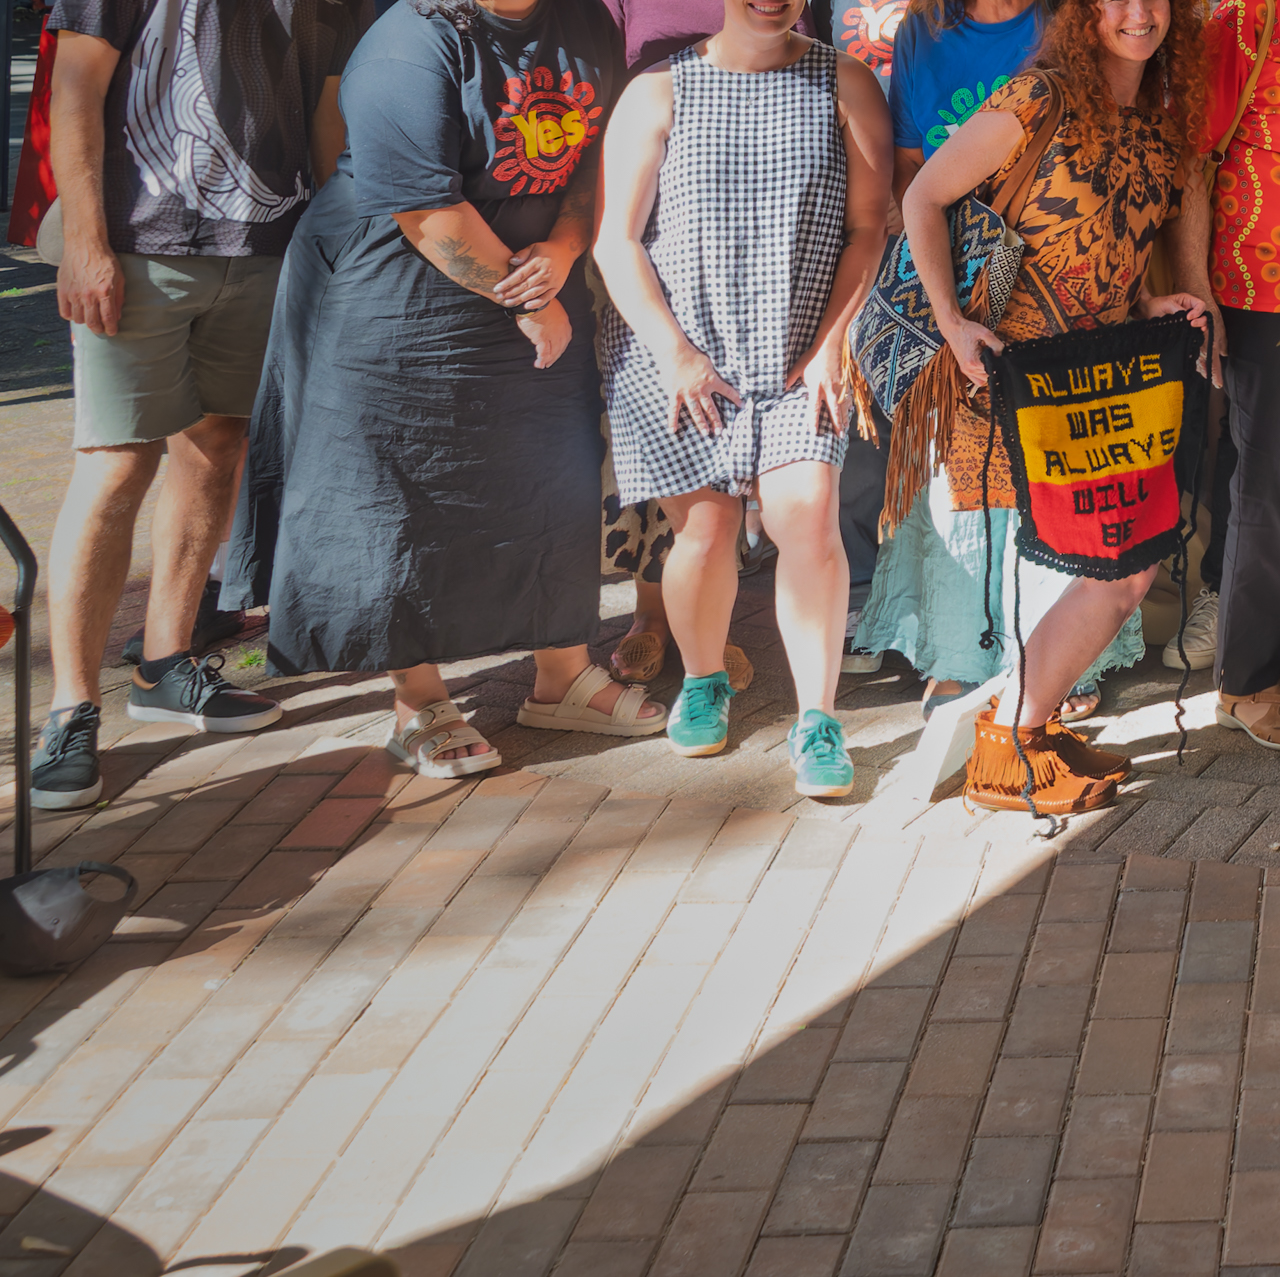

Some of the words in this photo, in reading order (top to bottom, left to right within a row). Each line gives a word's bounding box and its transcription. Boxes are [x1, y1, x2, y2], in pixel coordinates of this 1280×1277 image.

[510, 109, 586, 159] Yes
[1025, 354, 1163, 398] ALWAYS
[1066, 403, 1134, 441] WAS
[1044, 428, 1175, 477] ALWAYS
[1072, 477, 1149, 515] WILL
[1102, 518, 1136, 548] BE
